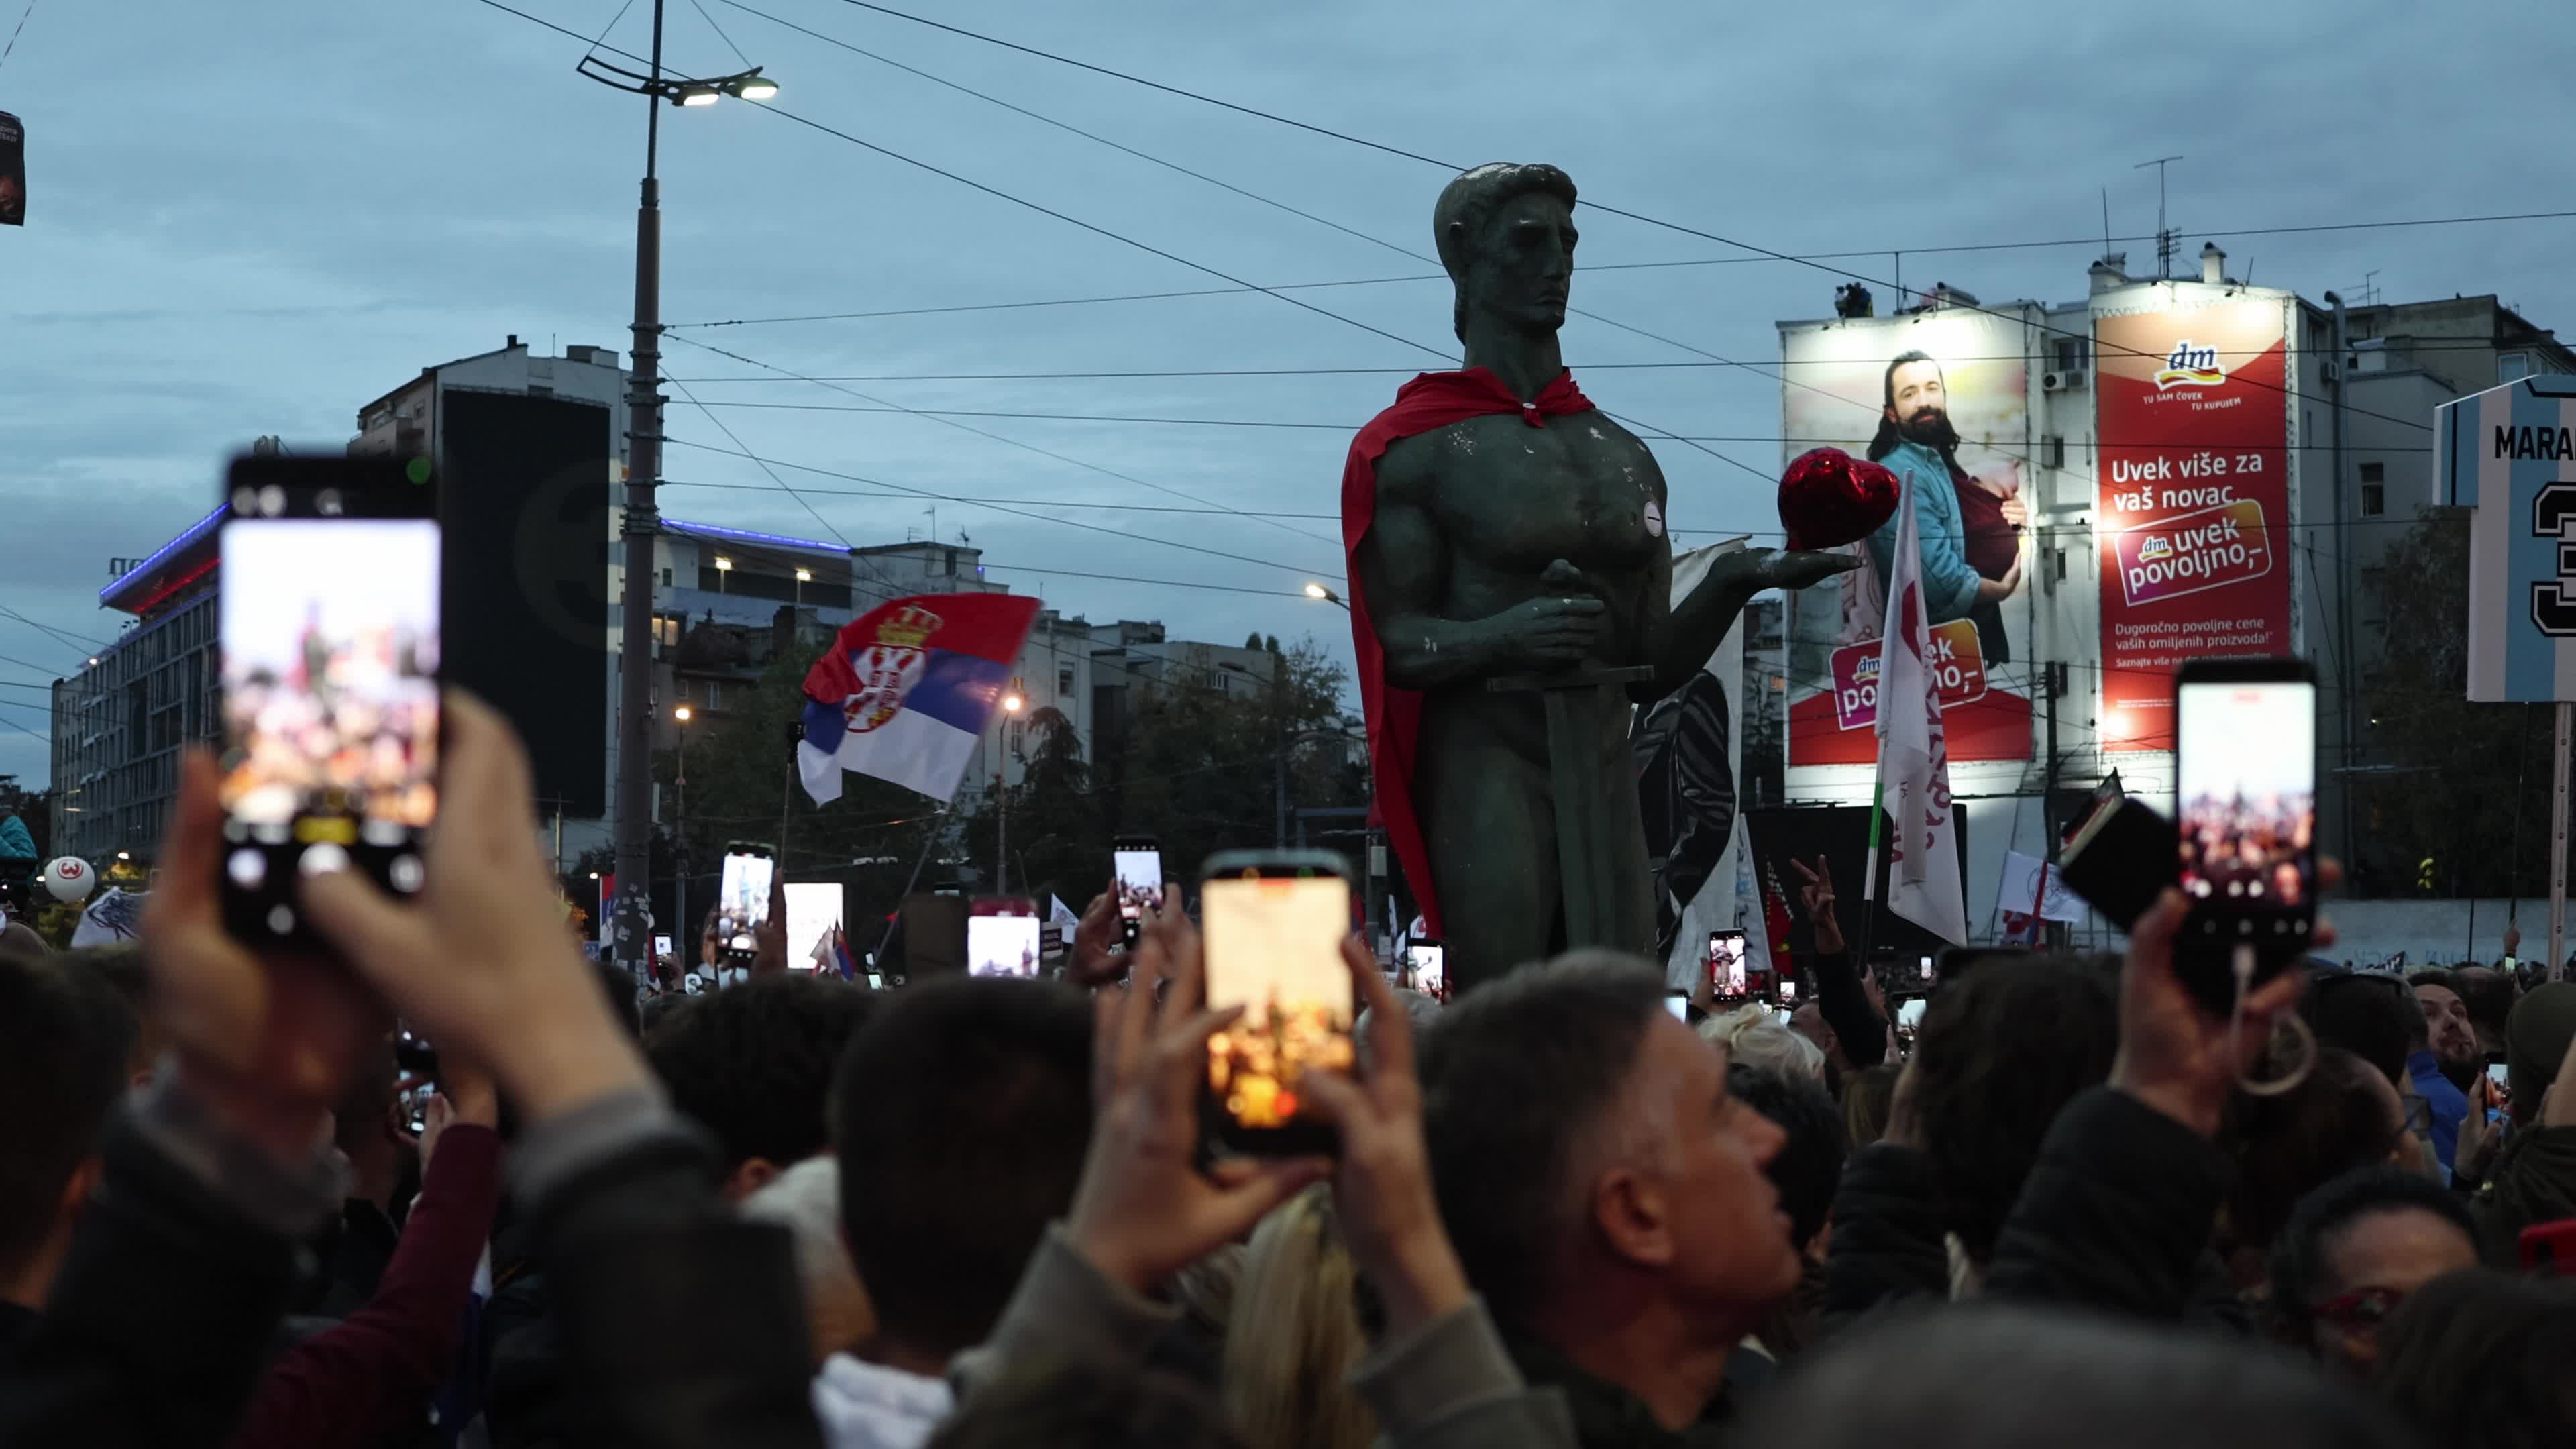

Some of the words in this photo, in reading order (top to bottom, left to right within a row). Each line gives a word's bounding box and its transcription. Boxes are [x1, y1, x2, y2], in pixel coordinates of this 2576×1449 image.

[2169, 343, 2215, 370] dm
[2143, 395, 2154, 405] TU
[2157, 392, 2174, 401] SAM
[2176, 391, 2203, 401] ČOVEK
[2191, 402, 2202, 411] TU
[2204, 396, 2241, 410] KUPUJEM
[2495, 425, 2576, 460] MARA
[2113, 455, 2172, 483] Uvek
[2179, 452, 2227, 478] više
[2235, 453, 2263, 473] za
[2114, 486, 2154, 512] vaš
[2144, 538, 2167, 552] dm
[2175, 517, 2240, 552] uvek
[2129, 543, 2263, 595] povoljno,-
[2115, 621, 2180, 637] Dugoročno
[2183, 619, 2233, 634] povoljne
[2236, 618, 2265, 629] cene
[2116, 639, 2145, 651] vaših
[2149, 636, 2204, 650] omiljenih
[2115, 656, 2151, 669] Saznajte
[2154, 656, 2169, 666] više
